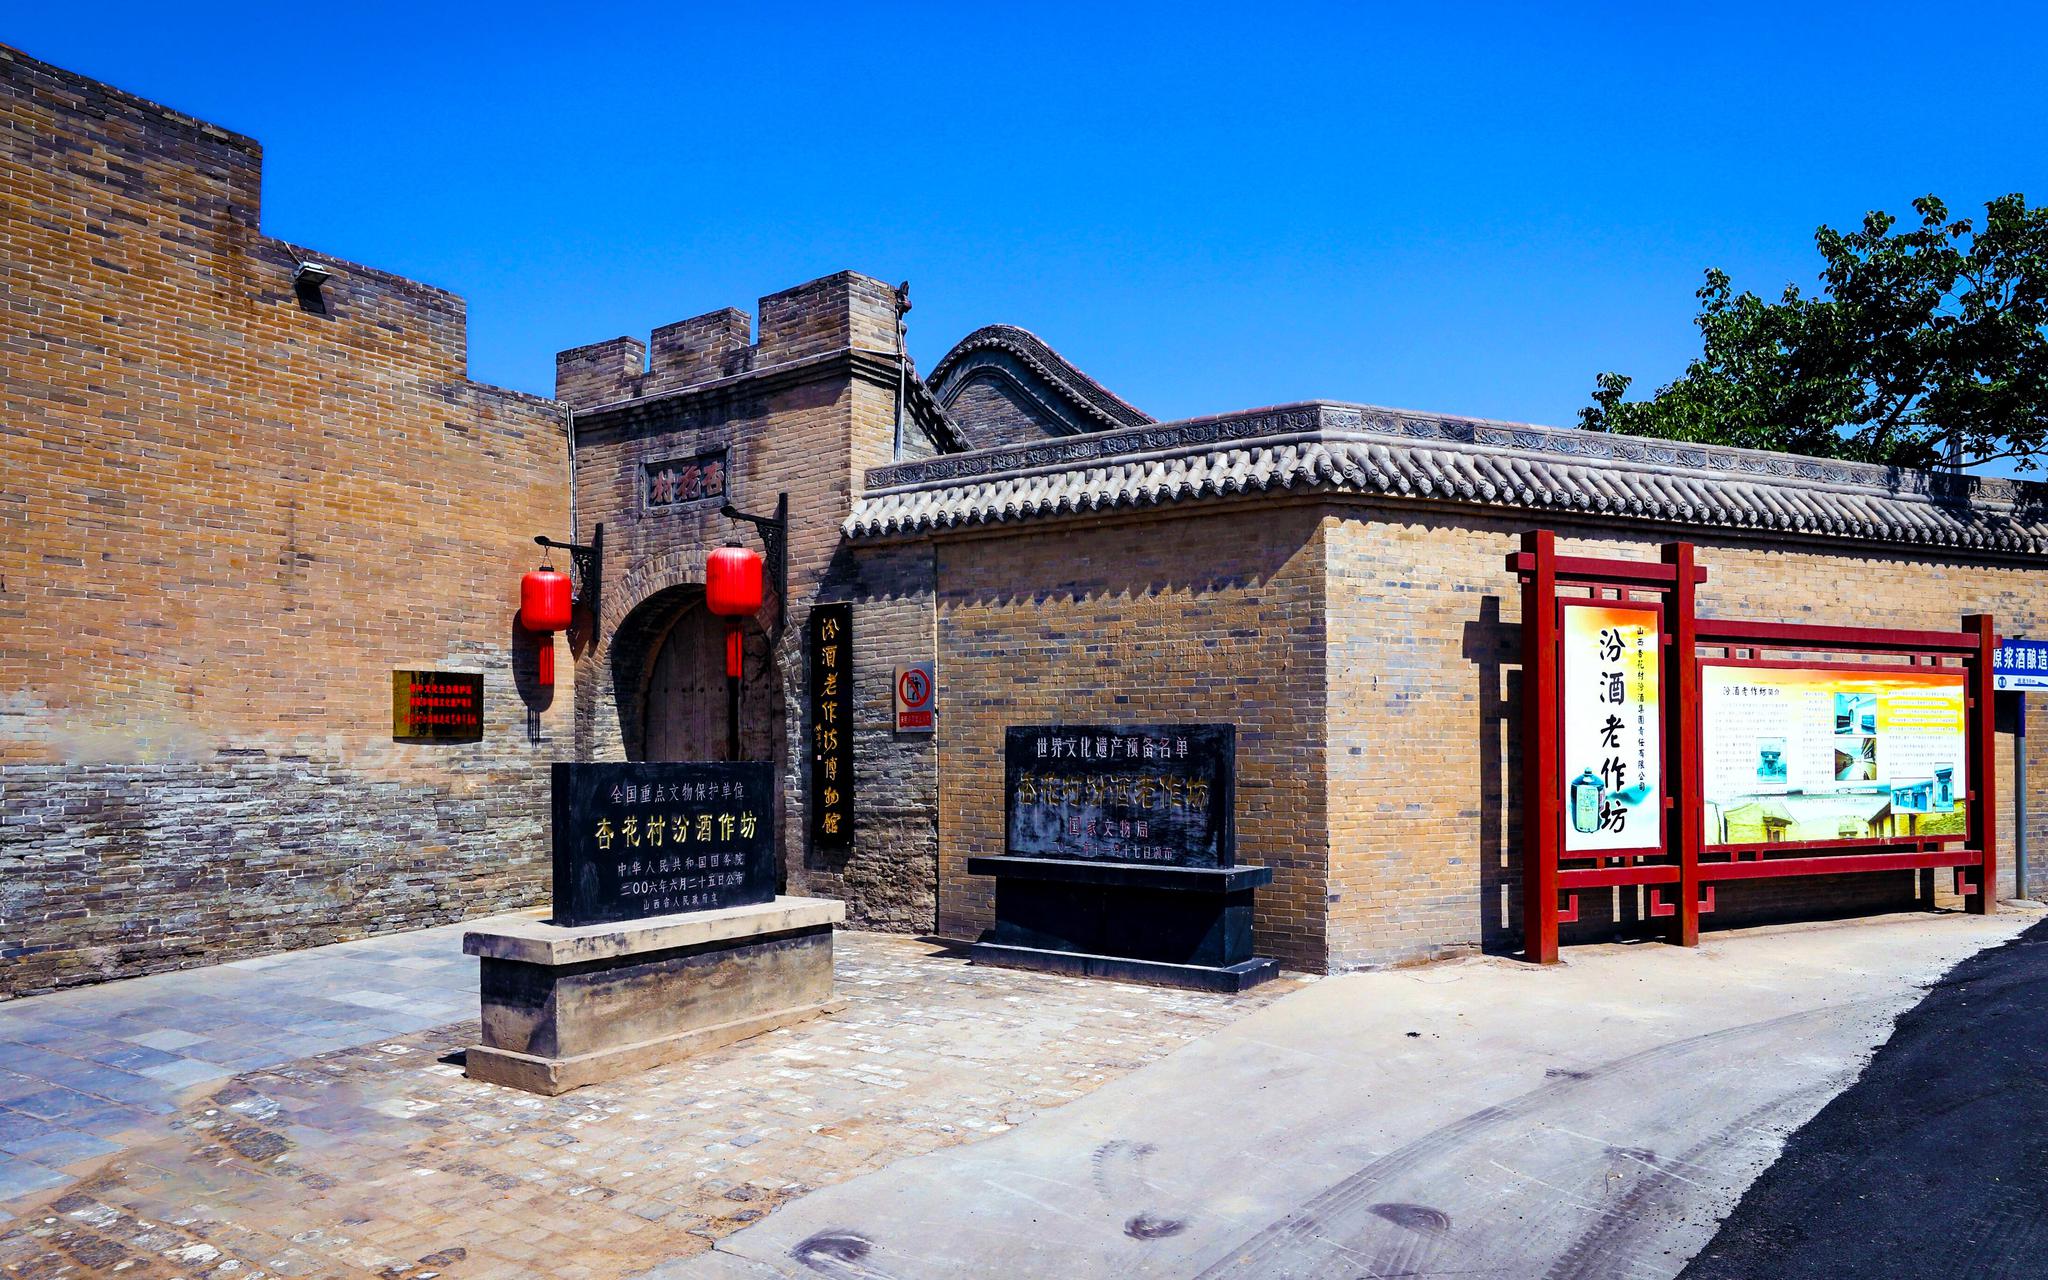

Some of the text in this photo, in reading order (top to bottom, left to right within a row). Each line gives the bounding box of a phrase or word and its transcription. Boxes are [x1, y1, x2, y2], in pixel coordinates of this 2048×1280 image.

[1993, 646, 2048, 670] 原浆酒酿造
[1723, 686, 1780, 697] 汾酒老作坊简介
[821, 618, 841, 834] 汾酒老作坊博物馆
[1599, 628, 1628, 834] 汾酒老作坊
[1036, 736, 1189, 759] 世界文化遗产预备名单
[610, 782, 745, 804] 全国重点文物保护单位
[594, 810, 758, 850] 杏花村汾酒作坊
[1068, 816, 1149, 838] 国家文物局
[617, 852, 746, 875] 中华人民共和国国务院
